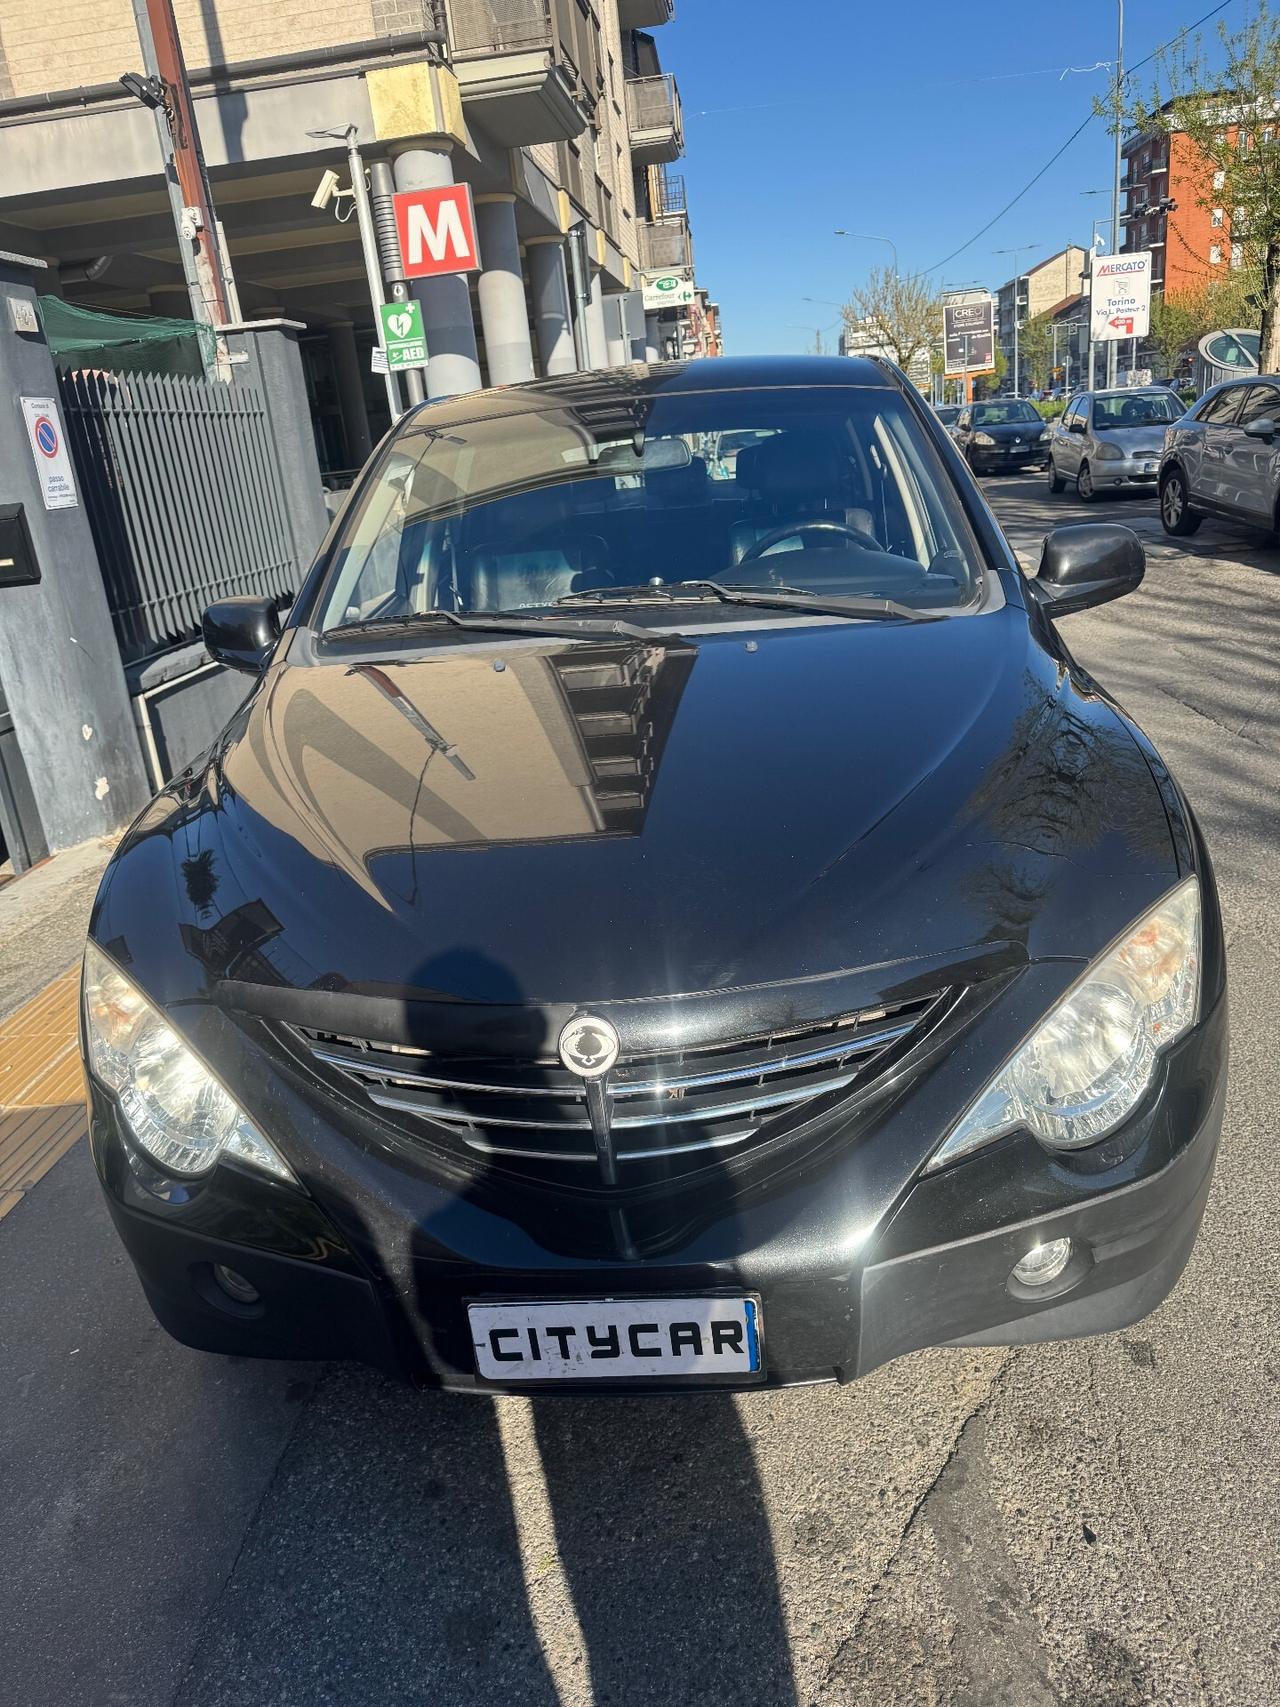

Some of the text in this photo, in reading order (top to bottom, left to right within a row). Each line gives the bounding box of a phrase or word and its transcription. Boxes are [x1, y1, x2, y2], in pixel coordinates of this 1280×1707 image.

[407, 200, 470, 265] M
[1107, 297, 1136, 307] Torino
[1096, 308, 1108, 316] Via
[1116, 306, 1140, 314] Pasteur
[402, 347, 425, 361] AED
[48, 475, 64, 484] passo
[48, 484, 70, 493] carrabile
[488, 1320, 745, 1362] CITYCAR
